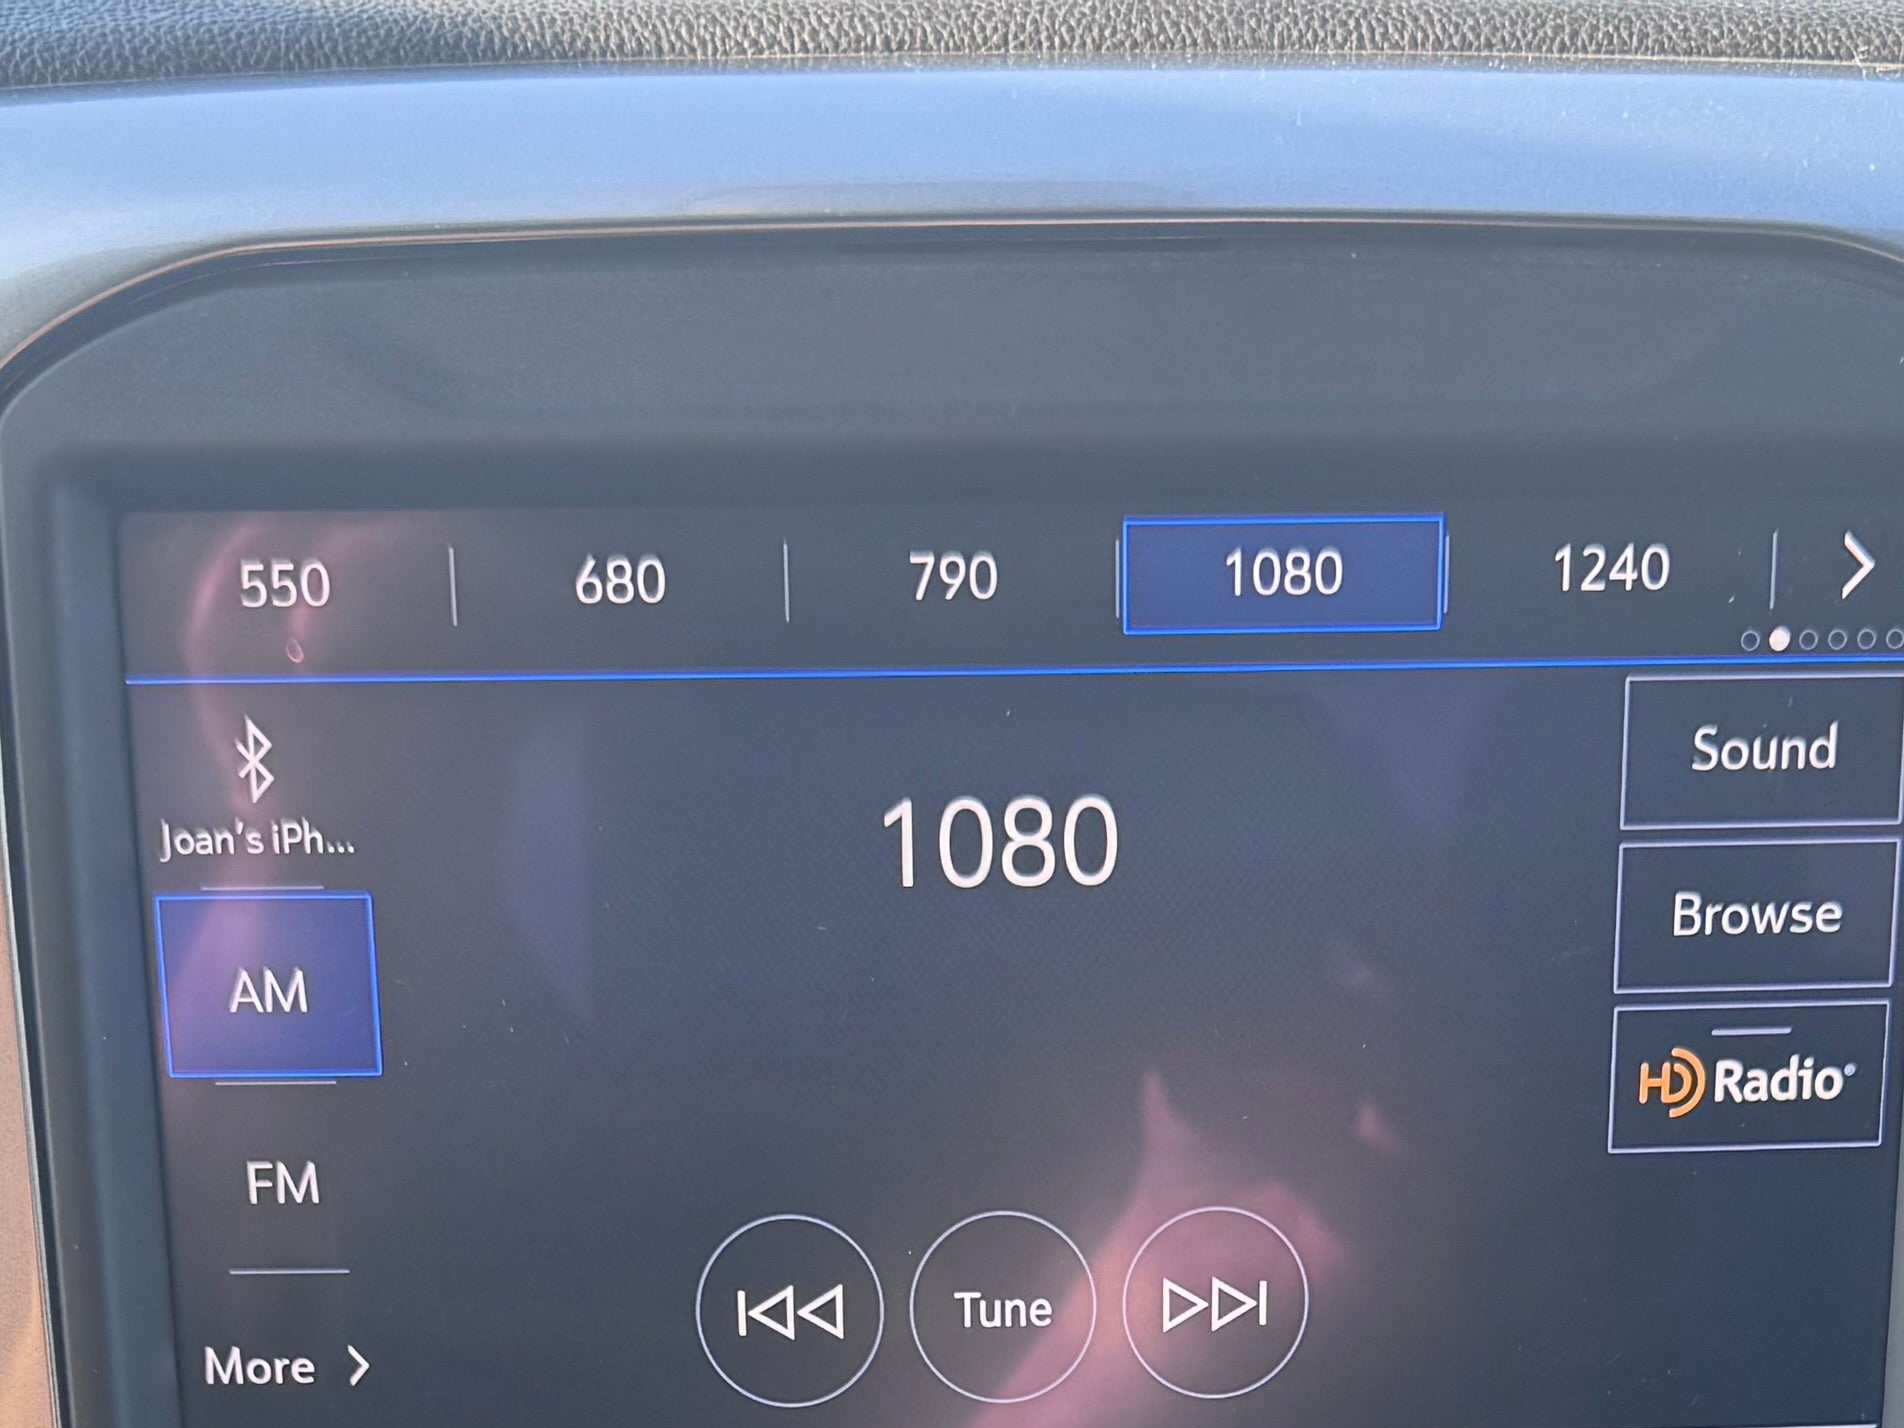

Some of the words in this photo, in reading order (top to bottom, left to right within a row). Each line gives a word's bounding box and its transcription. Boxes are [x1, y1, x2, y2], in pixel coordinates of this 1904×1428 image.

[238, 558, 332, 608] 550
[574, 554, 667, 605] 680
[908, 549, 998, 602] 790
[1224, 546, 1344, 597] 1080
[1553, 542, 1671, 593] 1240
[1690, 721, 1840, 772] Sound
[159, 817, 265, 863] Joan's
[883, 794, 1120, 889] 1080
[1671, 890, 1844, 936] Browse
[228, 966, 309, 1014] AM
[246, 1160, 321, 1205] FM
[953, 1290, 1053, 1329] Tune
[203, 1345, 316, 1385] More
